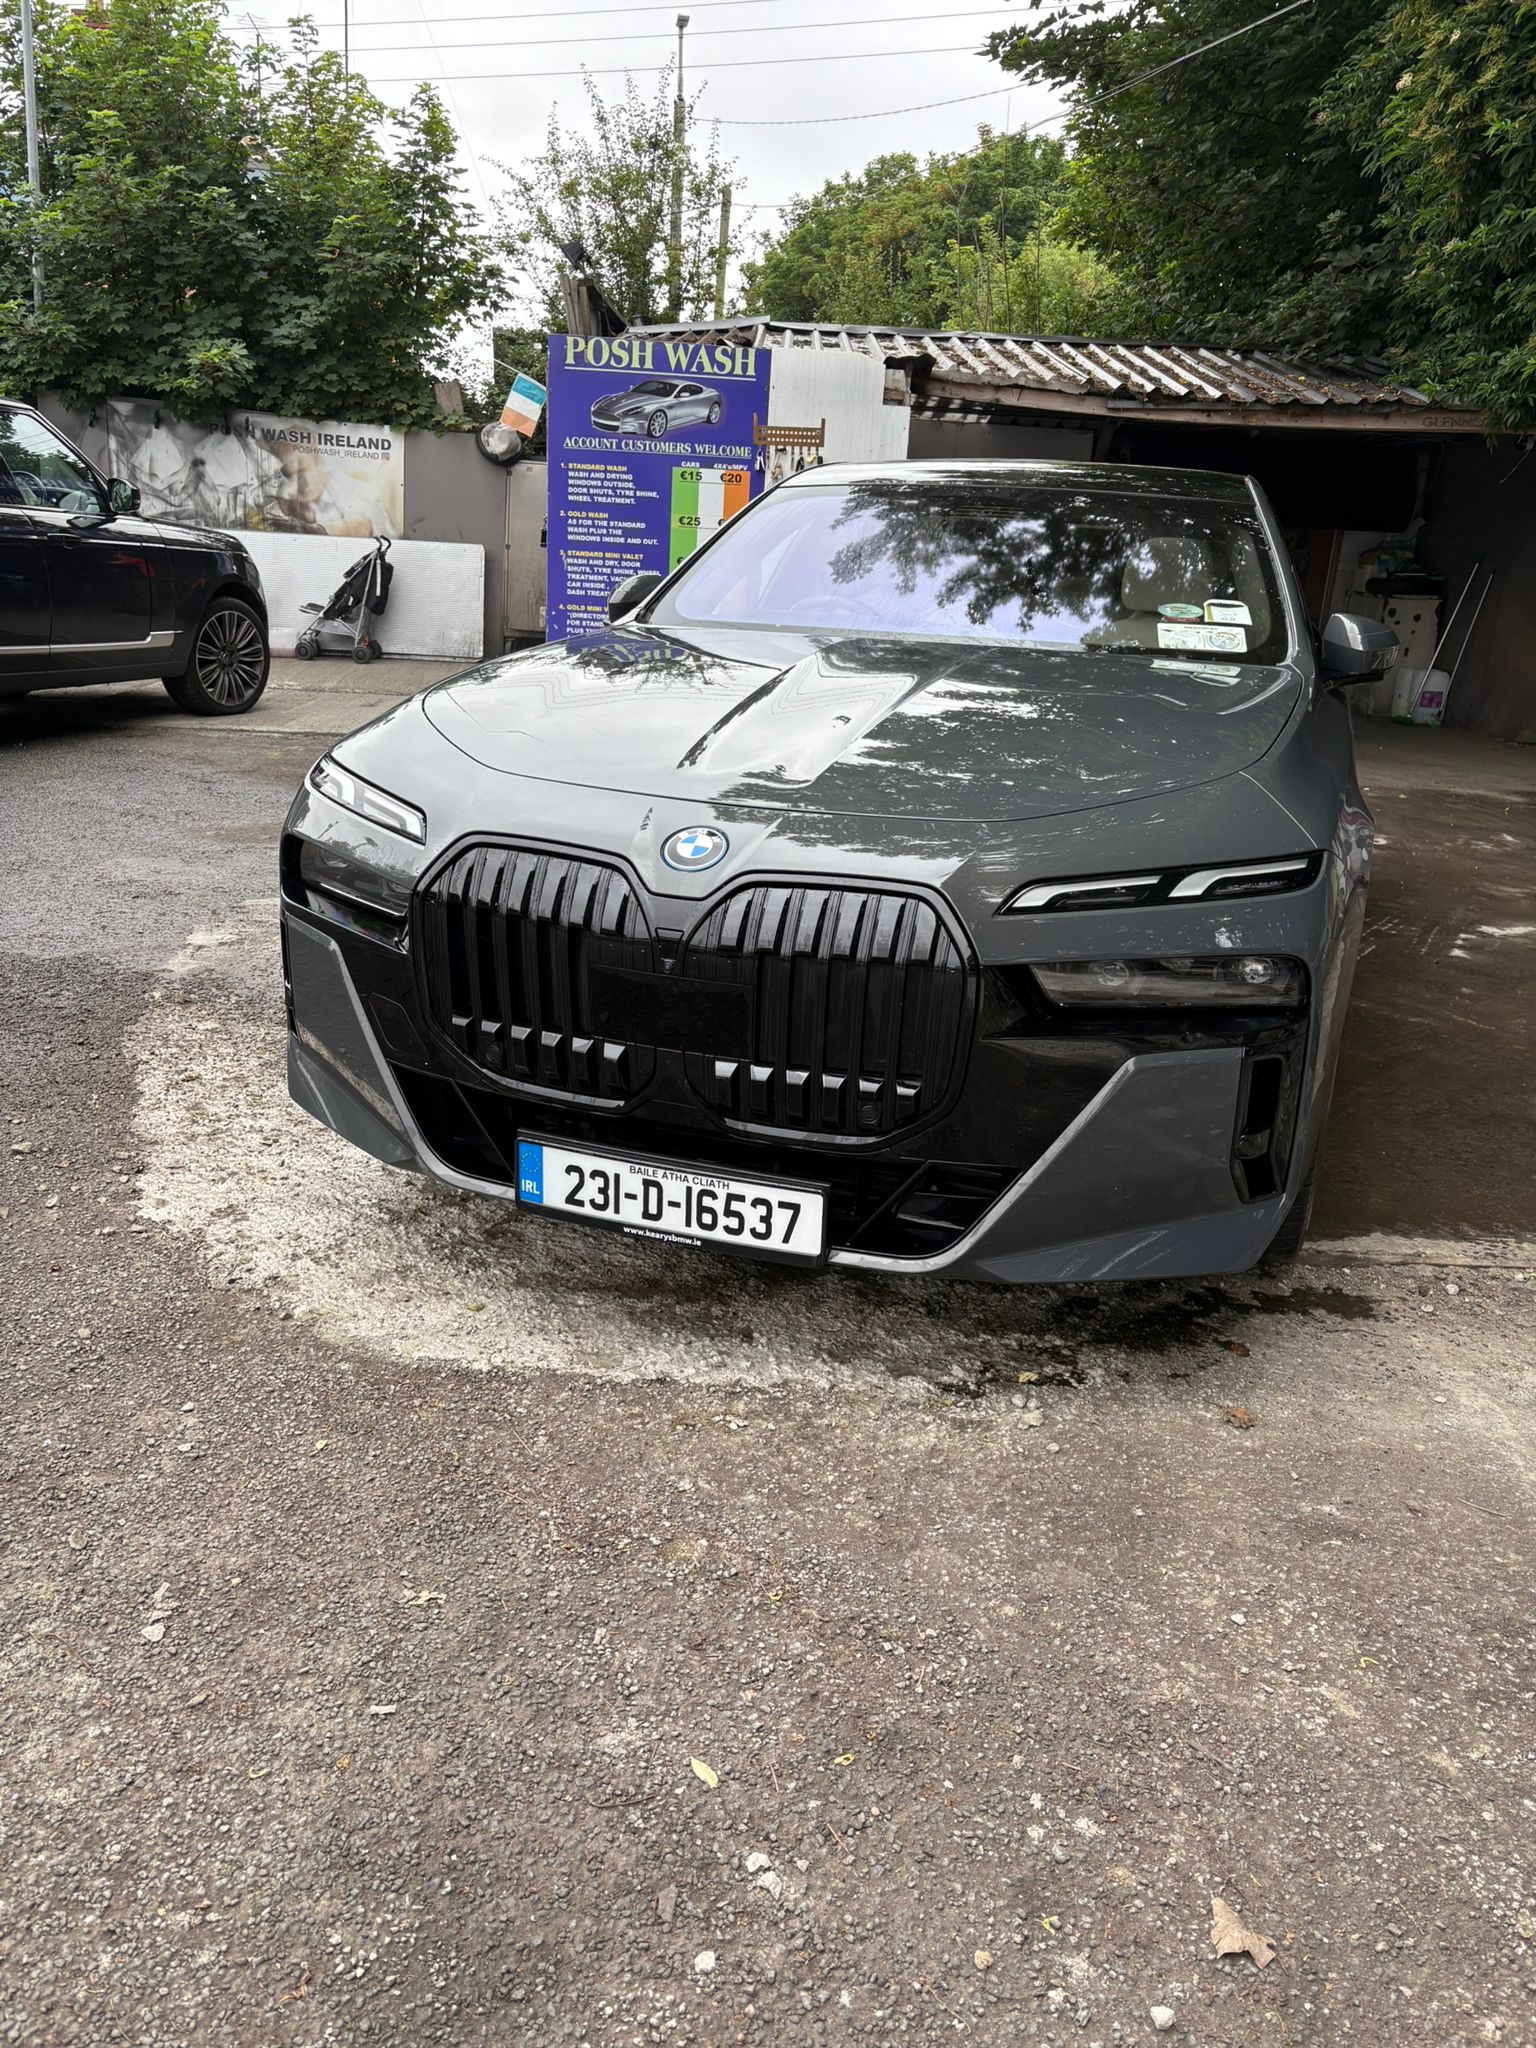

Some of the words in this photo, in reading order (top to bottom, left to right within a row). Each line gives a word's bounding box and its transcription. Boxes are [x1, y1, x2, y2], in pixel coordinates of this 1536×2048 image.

[564, 336, 654, 370] POSH
[664, 342, 756, 376] WASH
[261, 428, 312, 444] WASH
[318, 433, 392, 451] IRELAND
[563, 436, 619, 450] ACCOUNT
[621, 439, 691, 455] CUSTOMERS
[694, 444, 752, 457] WELCOME
[292, 445, 379, 460] POSHWASH_IRELAND
[568, 463, 605, 471] STANDARD
[680, 470, 702, 481] €15
[720, 473, 742, 483] €20
[568, 479, 601, 487] WINDOWS
[603, 481, 636, 489] OUTSIDE,
[589, 488, 615, 496] SHUTS,
[616, 489, 634, 497] TYRE
[609, 521, 646, 529] STANDARD
[678, 516, 701, 526] €25
[567, 534, 601, 542] WINDOWS
[567, 550, 604, 558] STANDARD
[567, 565, 592, 573] SHUTS,
[629, 1165, 659, 1179] BAILE
[692, 1176, 730, 1191] CLIATH
[521, 1178, 541, 1196] IRL
[564, 1164, 801, 1244] 231-D-16537
[623, 1225, 702, 1247] www.kearysbmw.ie
